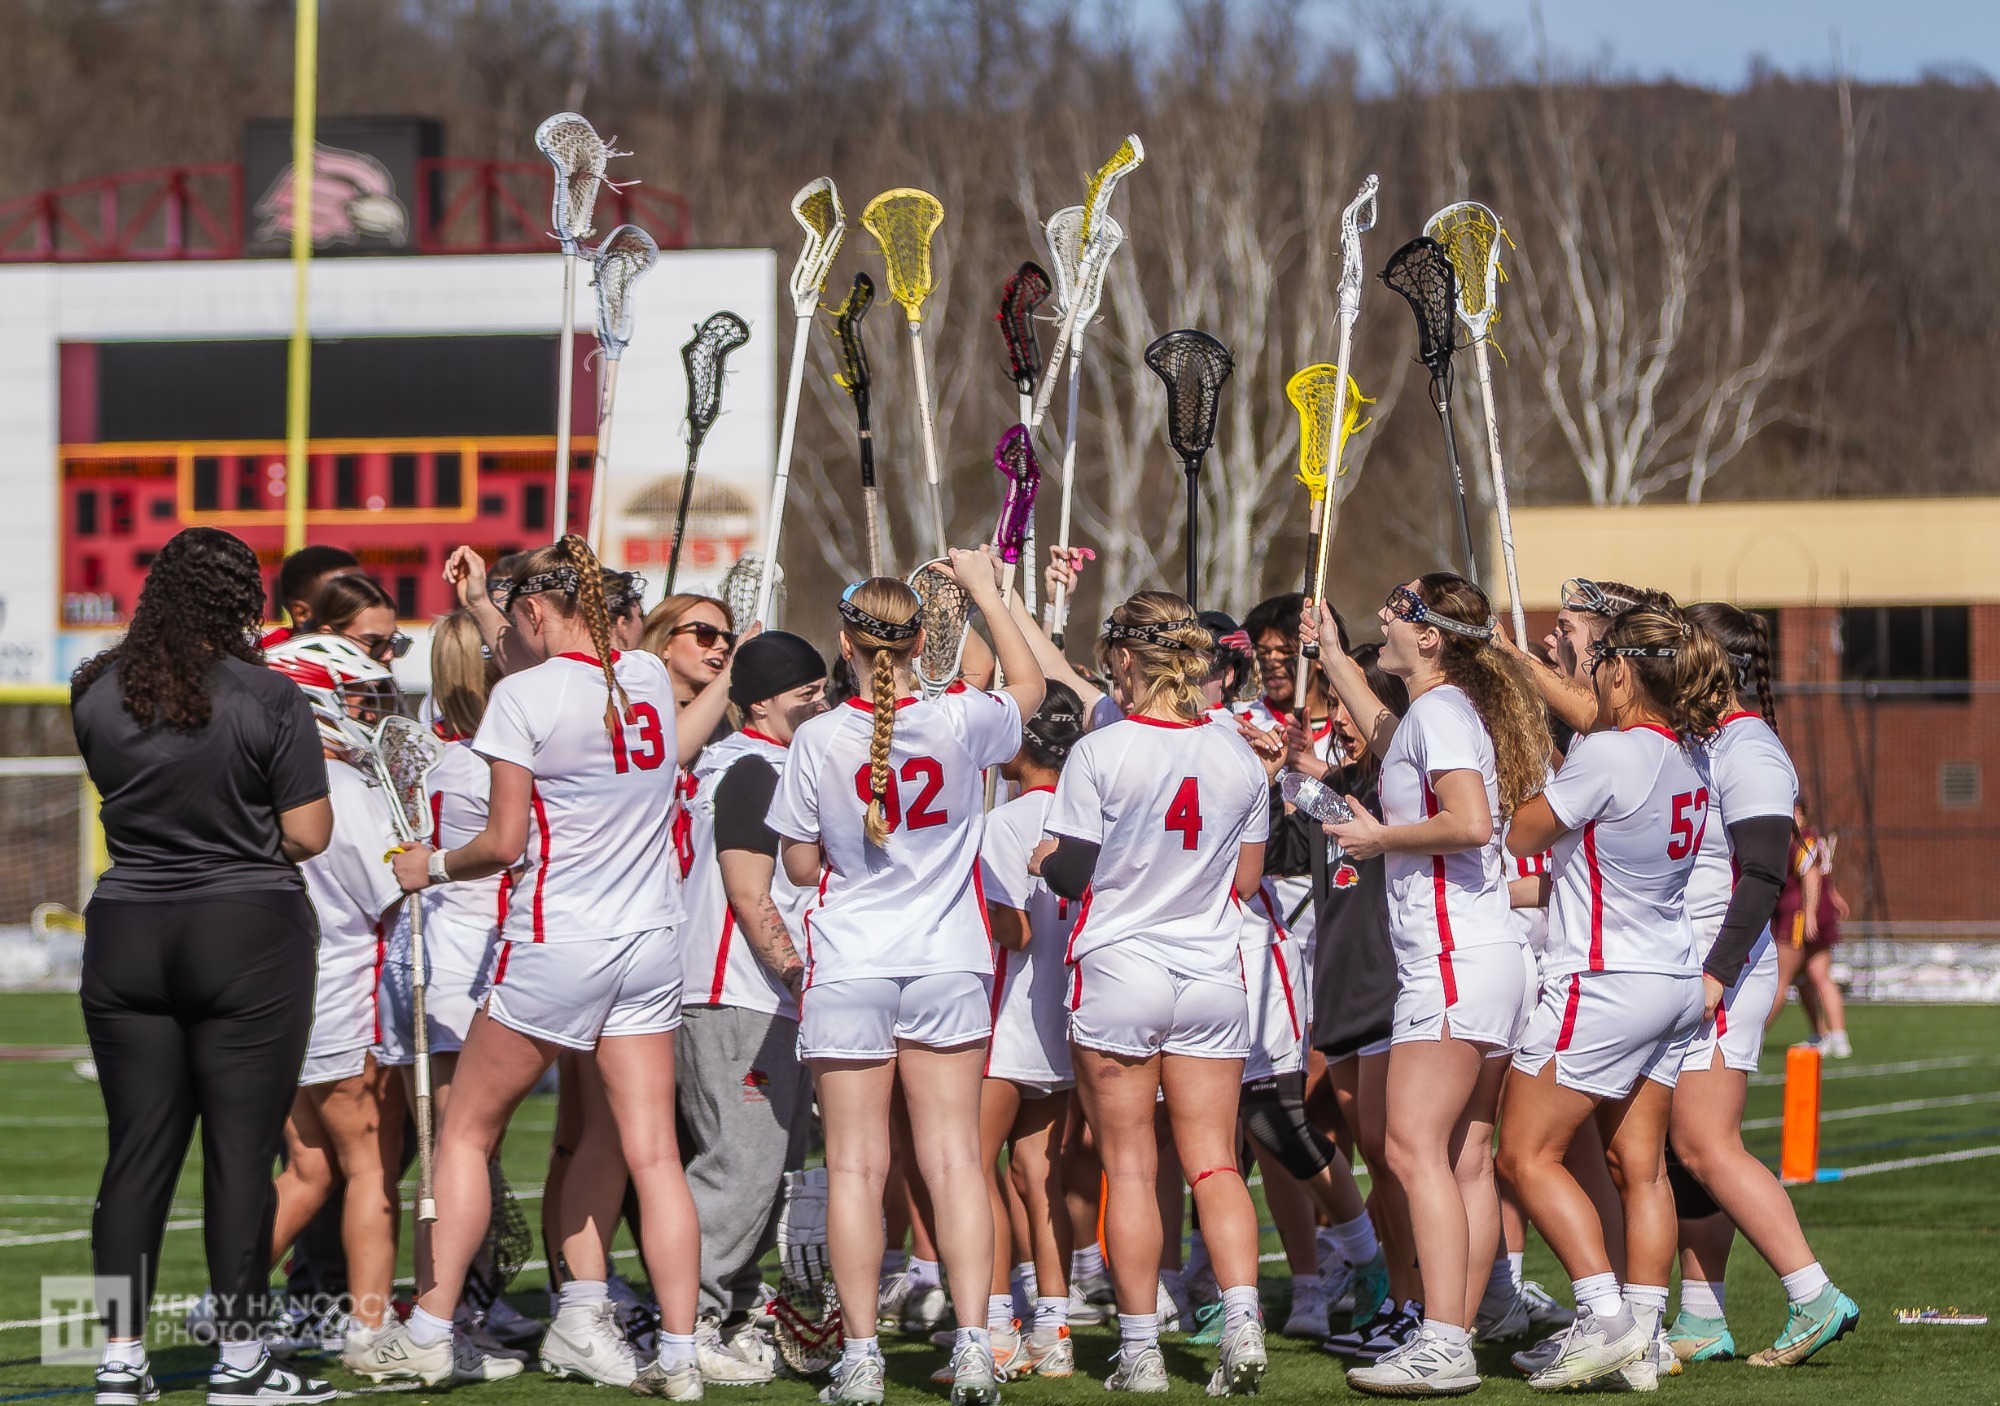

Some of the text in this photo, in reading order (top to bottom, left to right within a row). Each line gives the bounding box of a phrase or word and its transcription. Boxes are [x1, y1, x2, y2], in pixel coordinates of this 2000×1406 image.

[1051, 339, 1066, 367] GAIT
[528, 571, 554, 585] STX
[839, 601, 882, 629] STX STX
[1128, 628, 1150, 641] STX
[1155, 636, 1181, 649] STX
[1615, 648, 1647, 656] STX
[1050, 713, 1076, 722] STX
[604, 701, 666, 774] 13
[855, 755, 948, 834] 92
[1164, 776, 1203, 851] 4
[1667, 786, 1708, 860] 52
